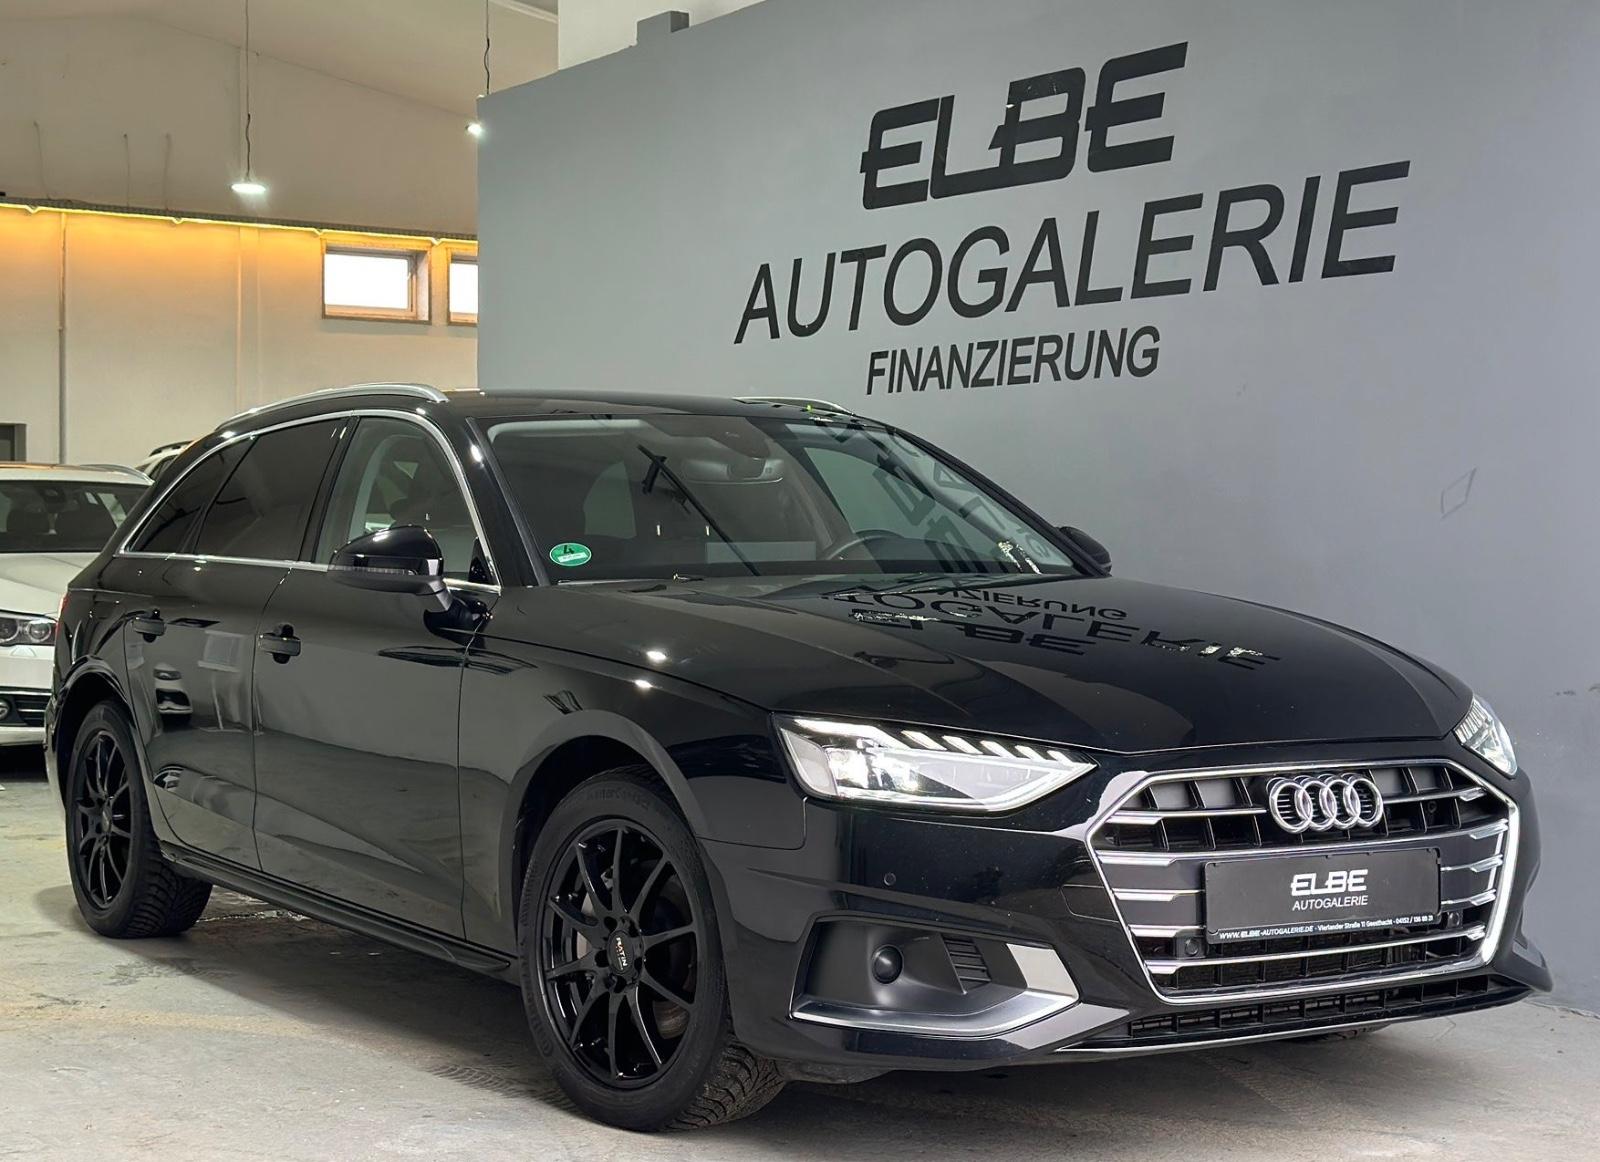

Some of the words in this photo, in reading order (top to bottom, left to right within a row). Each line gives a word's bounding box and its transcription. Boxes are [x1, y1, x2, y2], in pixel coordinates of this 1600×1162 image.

[860, 42, 1188, 209] ELBE
[734, 161, 1410, 344] AUTOGALERIE
[867, 326, 1160, 395] FINANZIERUNG
[1291, 869, 1368, 896] ELBE
[1292, 895, 1369, 911] AUTOGALERIE
